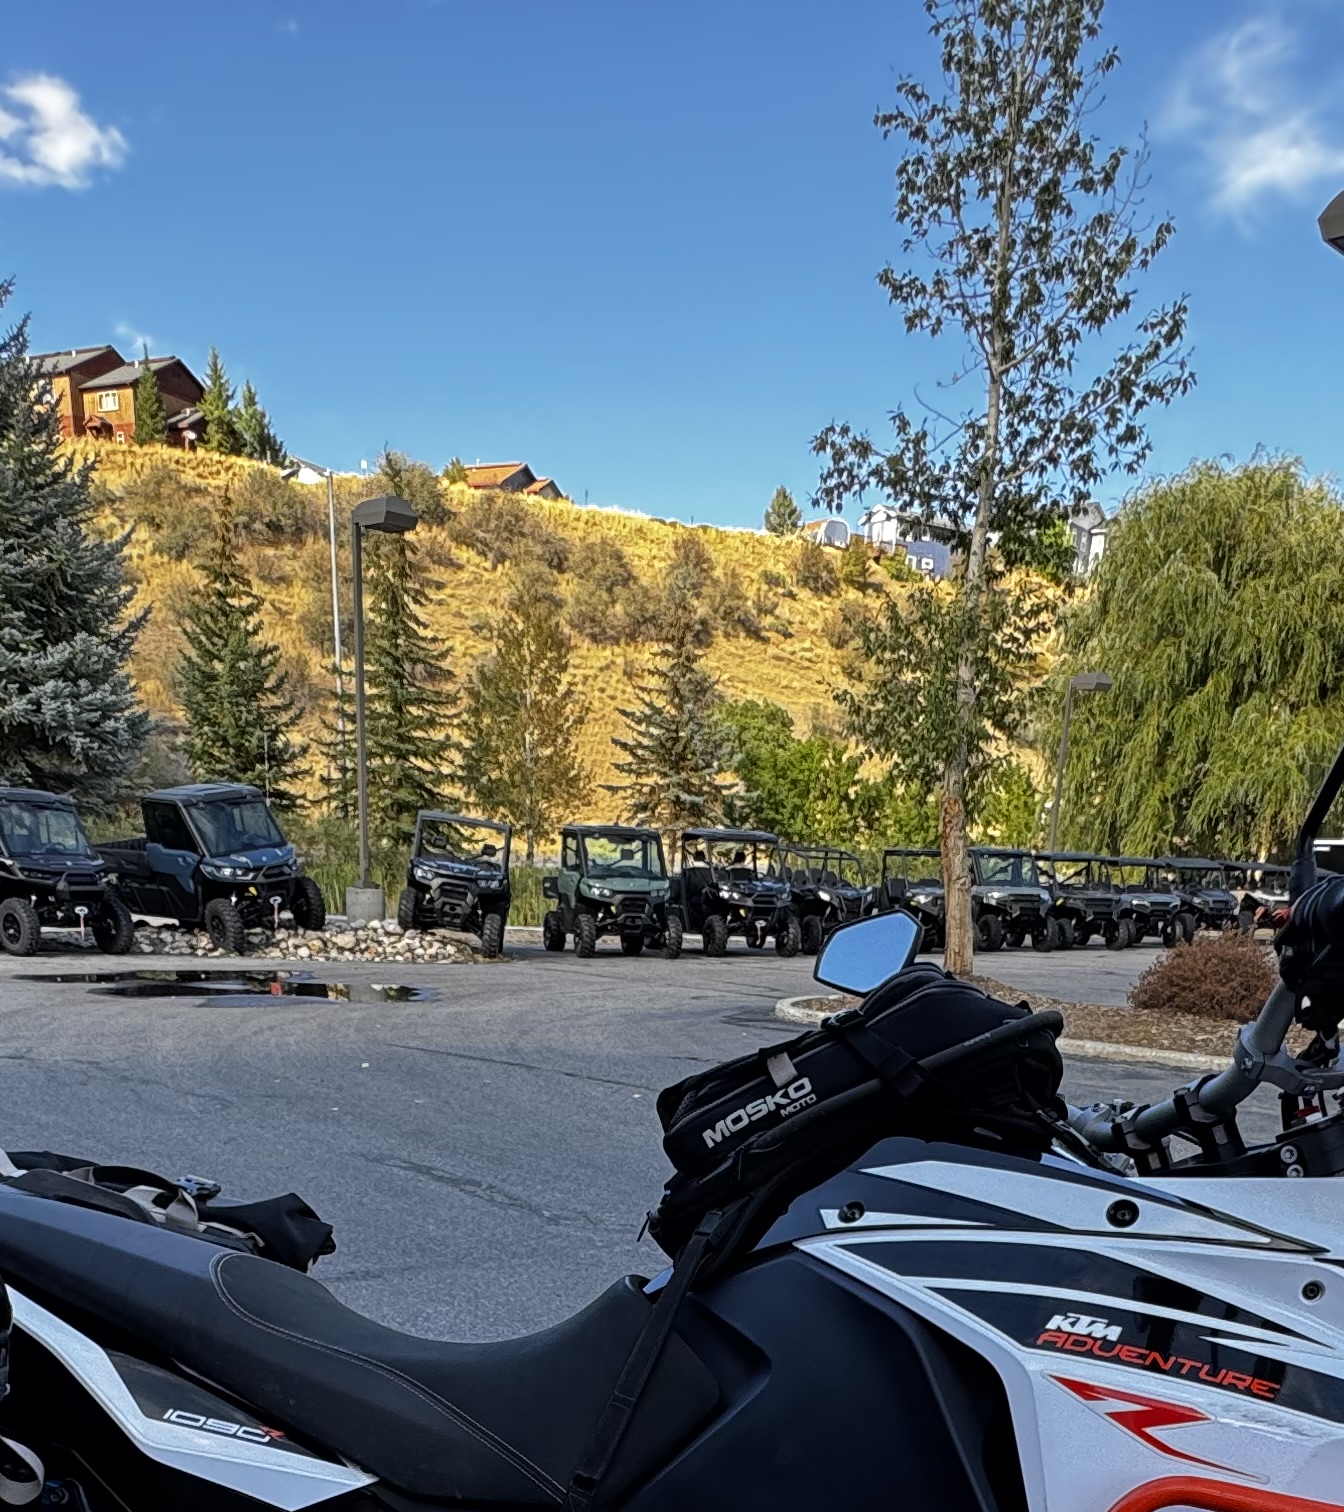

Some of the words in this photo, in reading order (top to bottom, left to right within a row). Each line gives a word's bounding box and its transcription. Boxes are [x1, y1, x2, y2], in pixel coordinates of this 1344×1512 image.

[702, 1076, 813, 1149] MOSKO
[780, 1093, 817, 1117] MOTO
[1045, 1312, 1124, 1342] KTM
[1036, 1331, 1281, 1399] ADVENTURE
